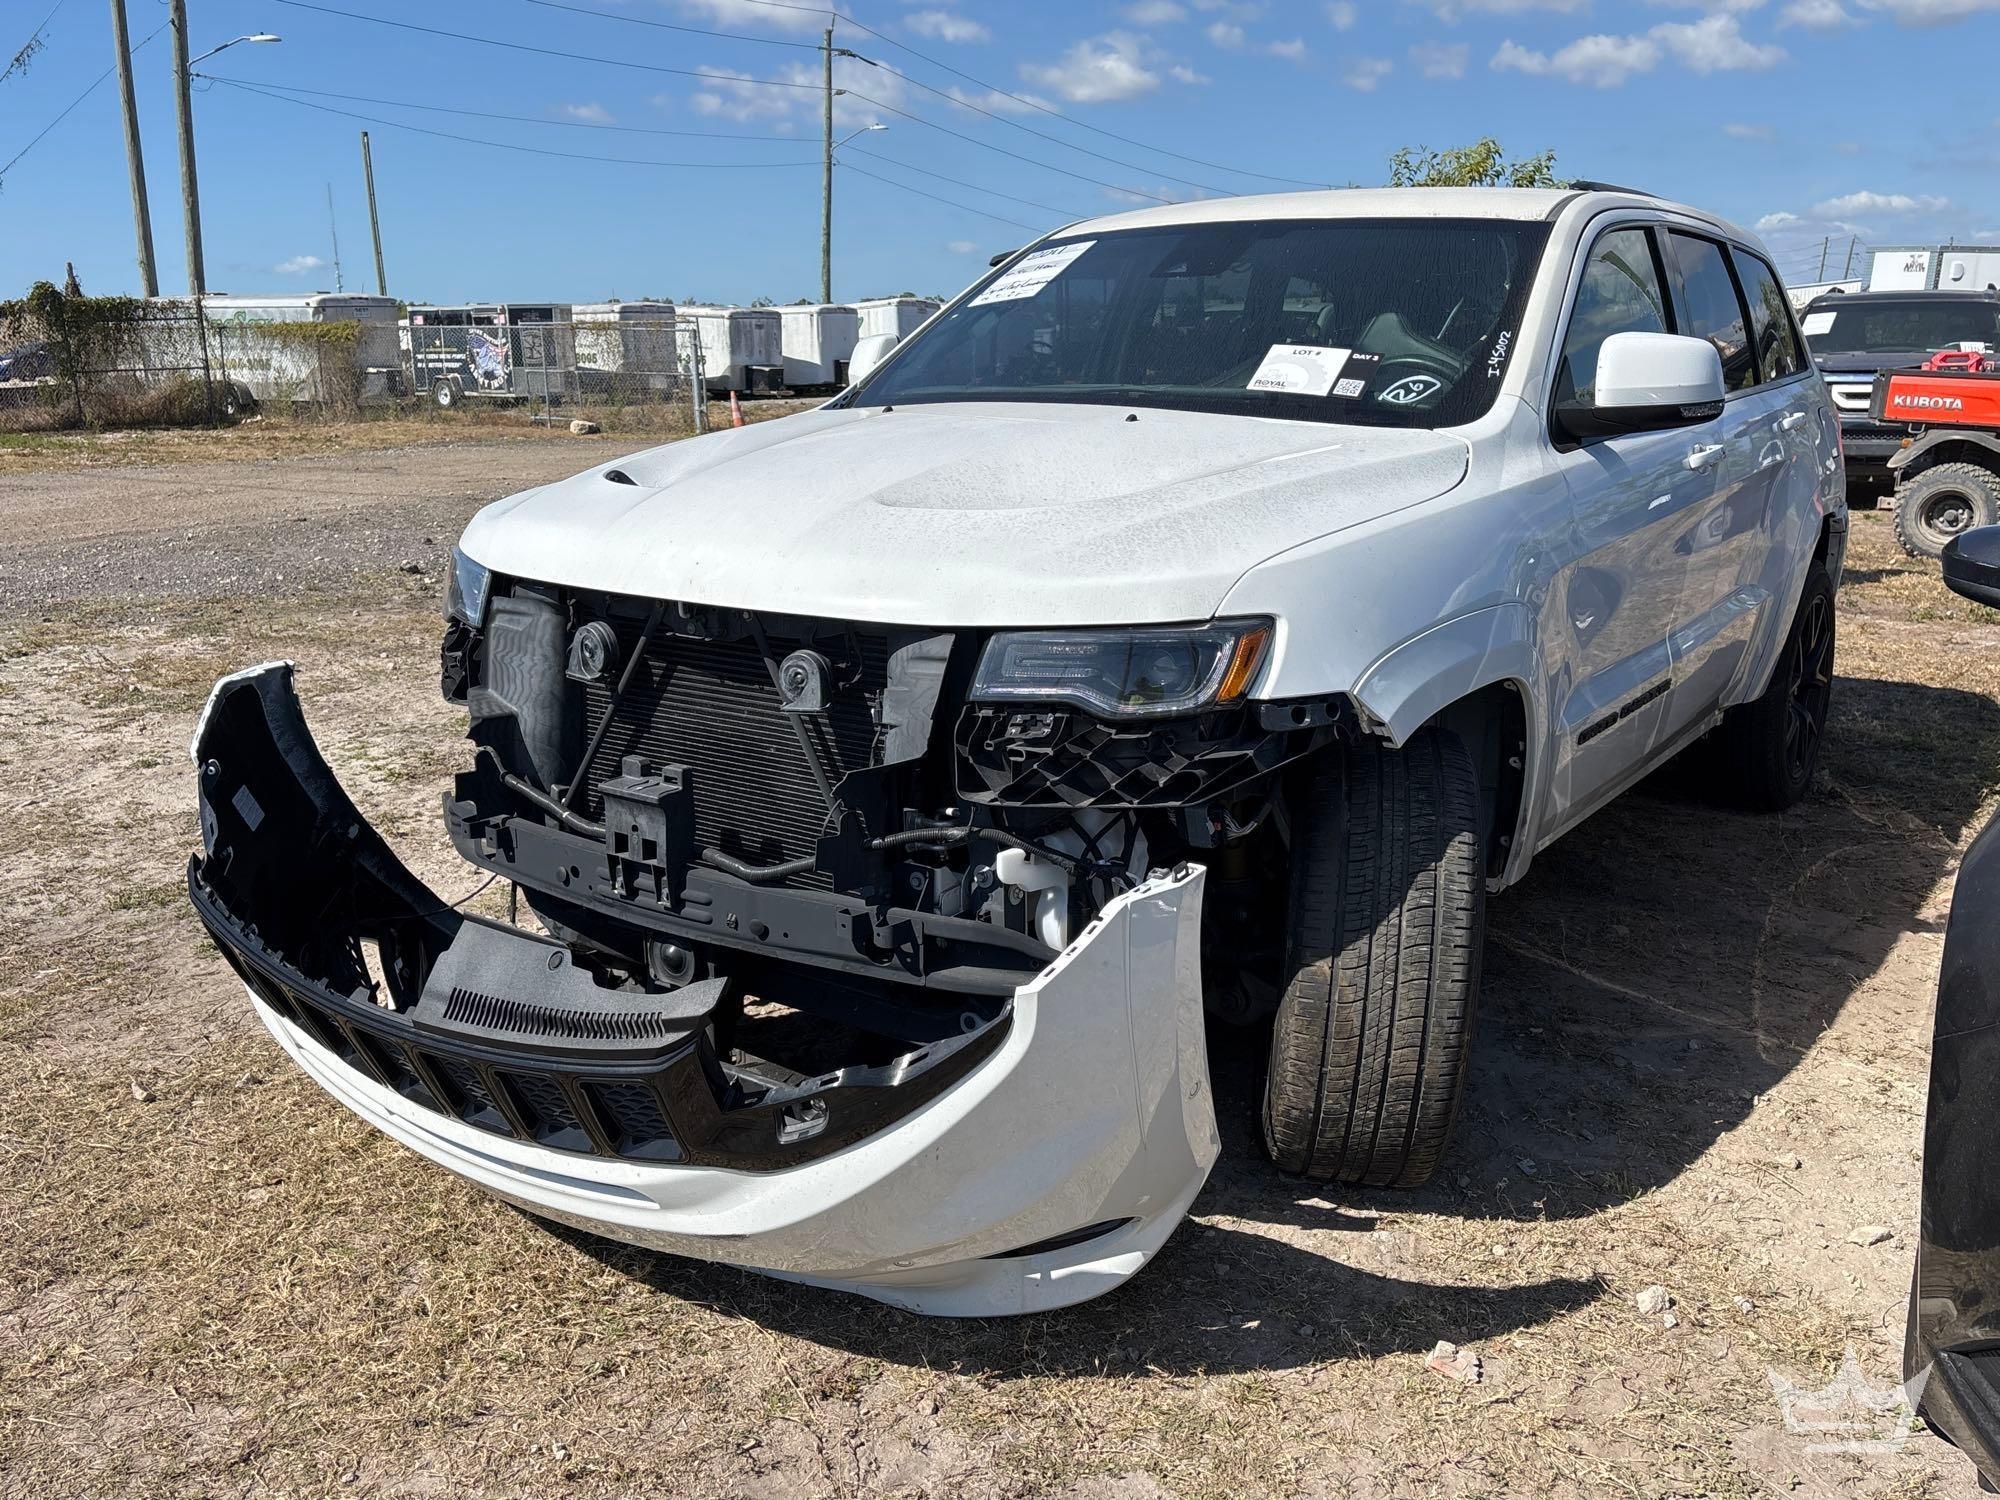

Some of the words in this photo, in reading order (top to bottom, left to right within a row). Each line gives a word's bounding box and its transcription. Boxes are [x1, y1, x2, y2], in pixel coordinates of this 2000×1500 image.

[1292, 348, 1313, 356] LOT
[1254, 379, 1287, 387] ROYAL
[1893, 395, 1963, 411] KUBOTA
